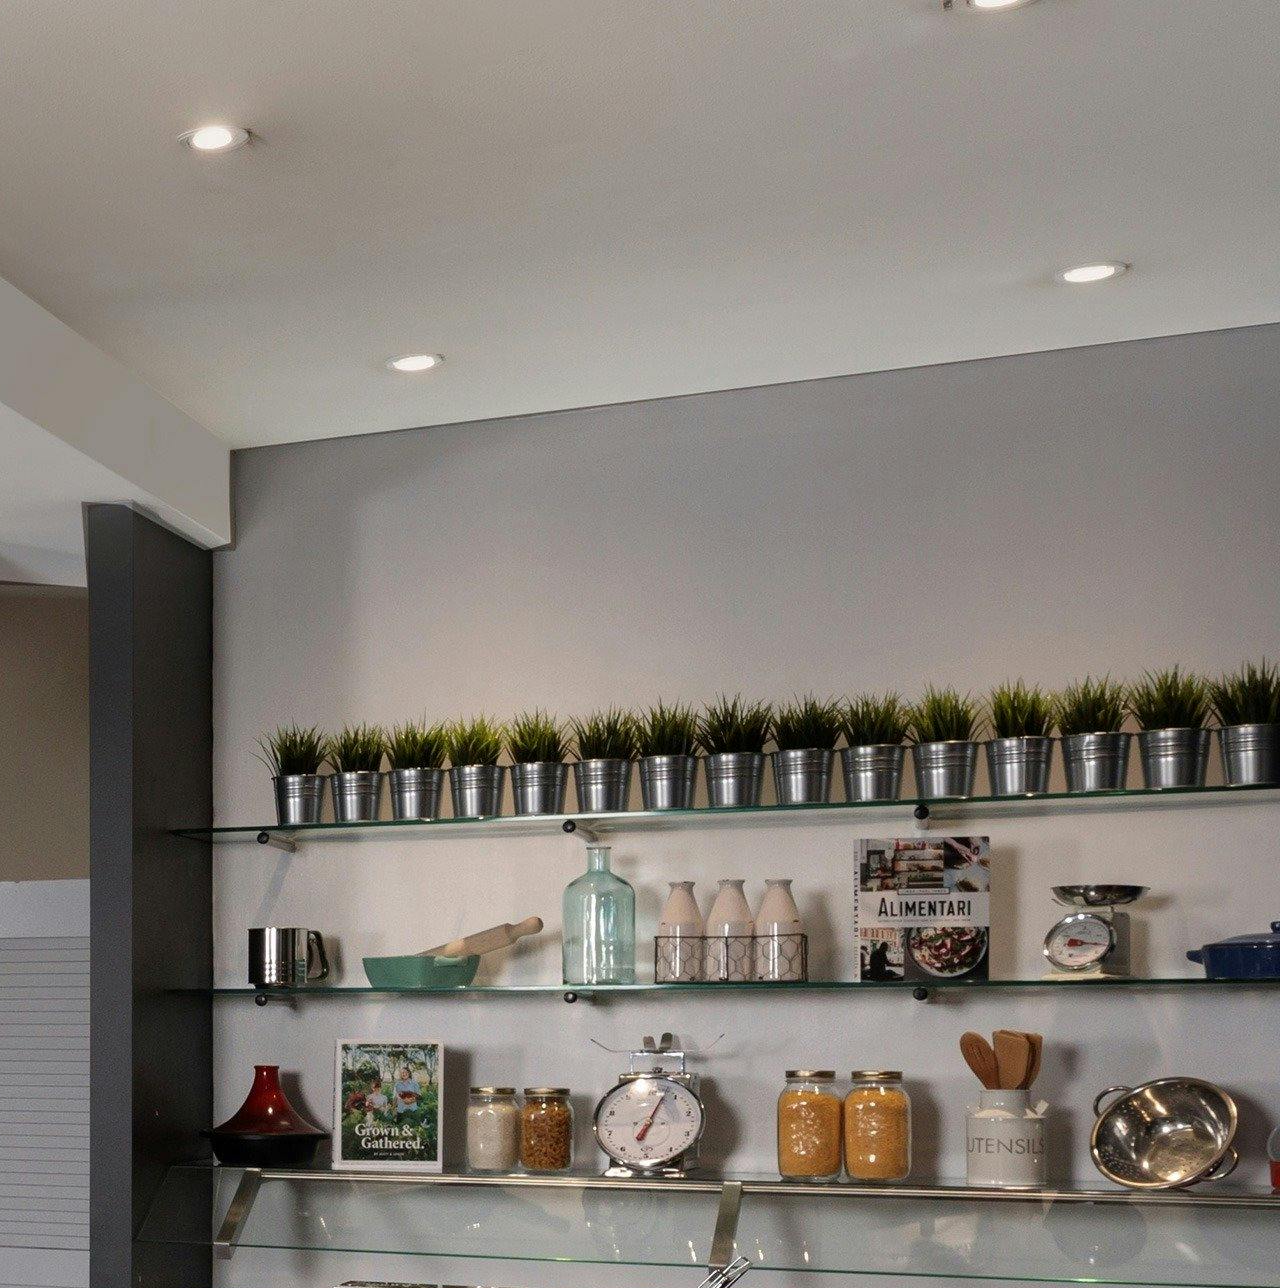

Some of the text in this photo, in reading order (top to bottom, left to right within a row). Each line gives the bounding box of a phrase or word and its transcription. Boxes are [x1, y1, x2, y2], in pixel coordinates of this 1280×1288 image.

[878, 897, 971, 917] ALIMENTARI
[355, 1123, 413, 1136] Grown &
[361, 1136, 425, 1149] Gathered.
[966, 1137, 1045, 1154] UTENSILS
